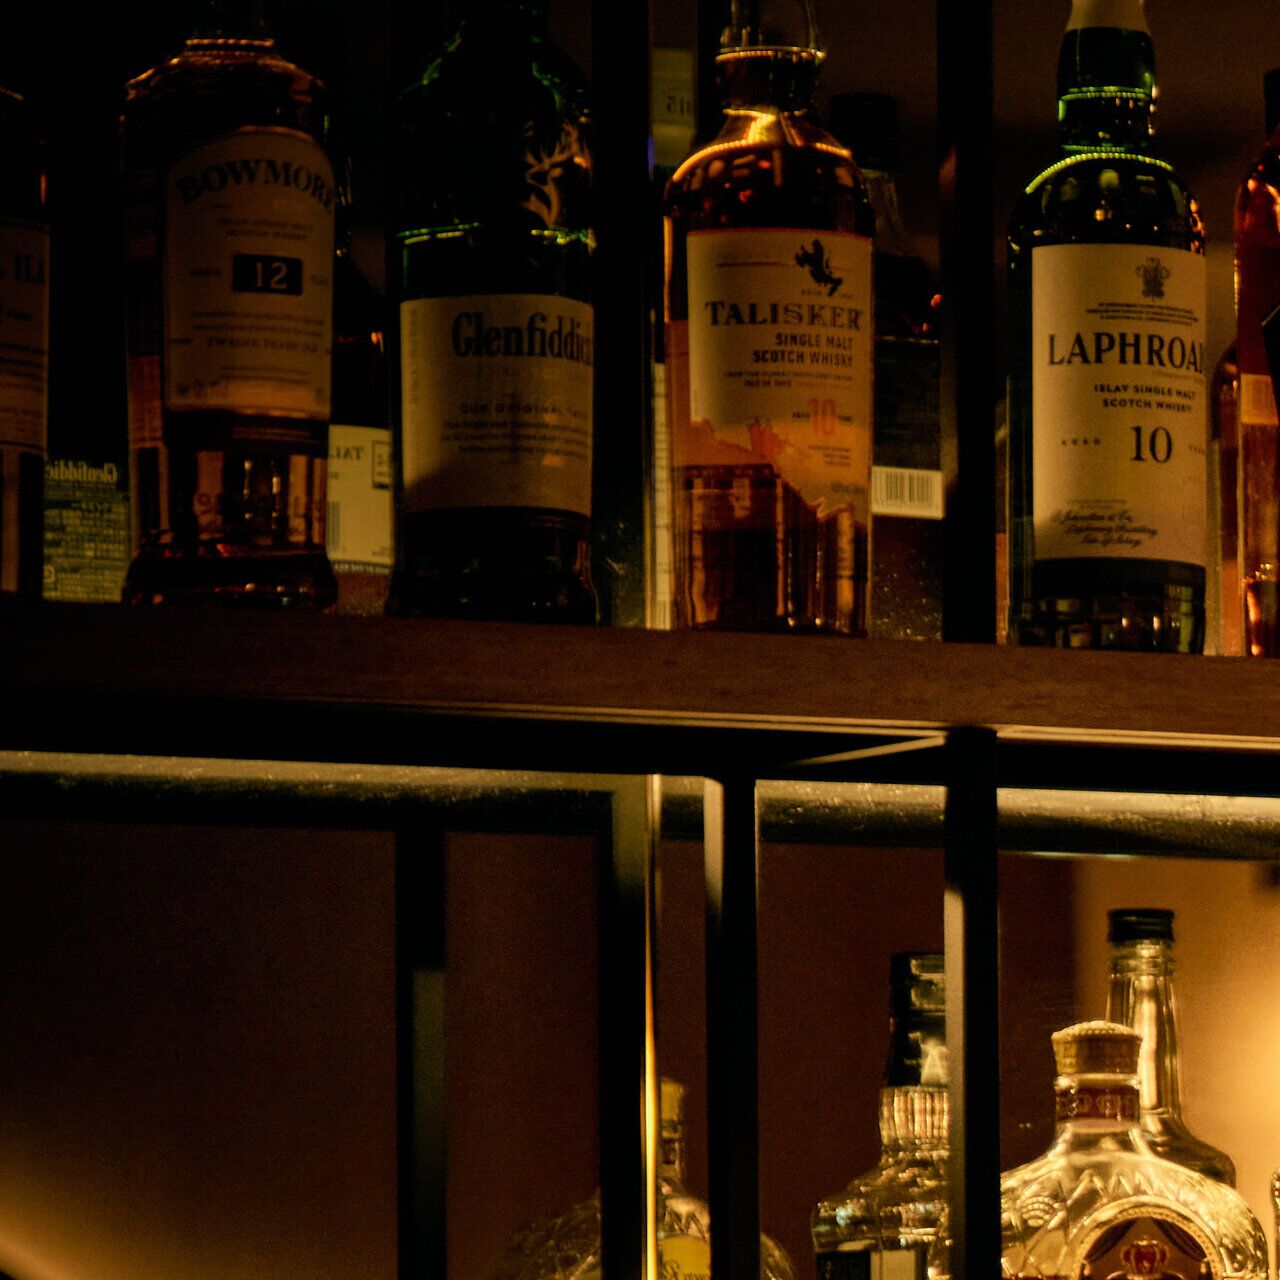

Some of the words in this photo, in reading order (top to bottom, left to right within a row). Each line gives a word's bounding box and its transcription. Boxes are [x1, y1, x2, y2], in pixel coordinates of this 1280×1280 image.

[255, 261, 288, 290] 12
[705, 301, 863, 331] TALISKER
[775, 332, 821, 347] SINGLE
[826, 335, 854, 350] MALT
[753, 350, 805, 364] SCOTCH
[809, 352, 853, 368] WHISKY
[1049, 332, 1203, 374] LAPHROA
[1132, 384, 1172, 397] SINGLE
[1103, 397, 1152, 409] SCOTCH
[1130, 425, 1173, 464] 10
